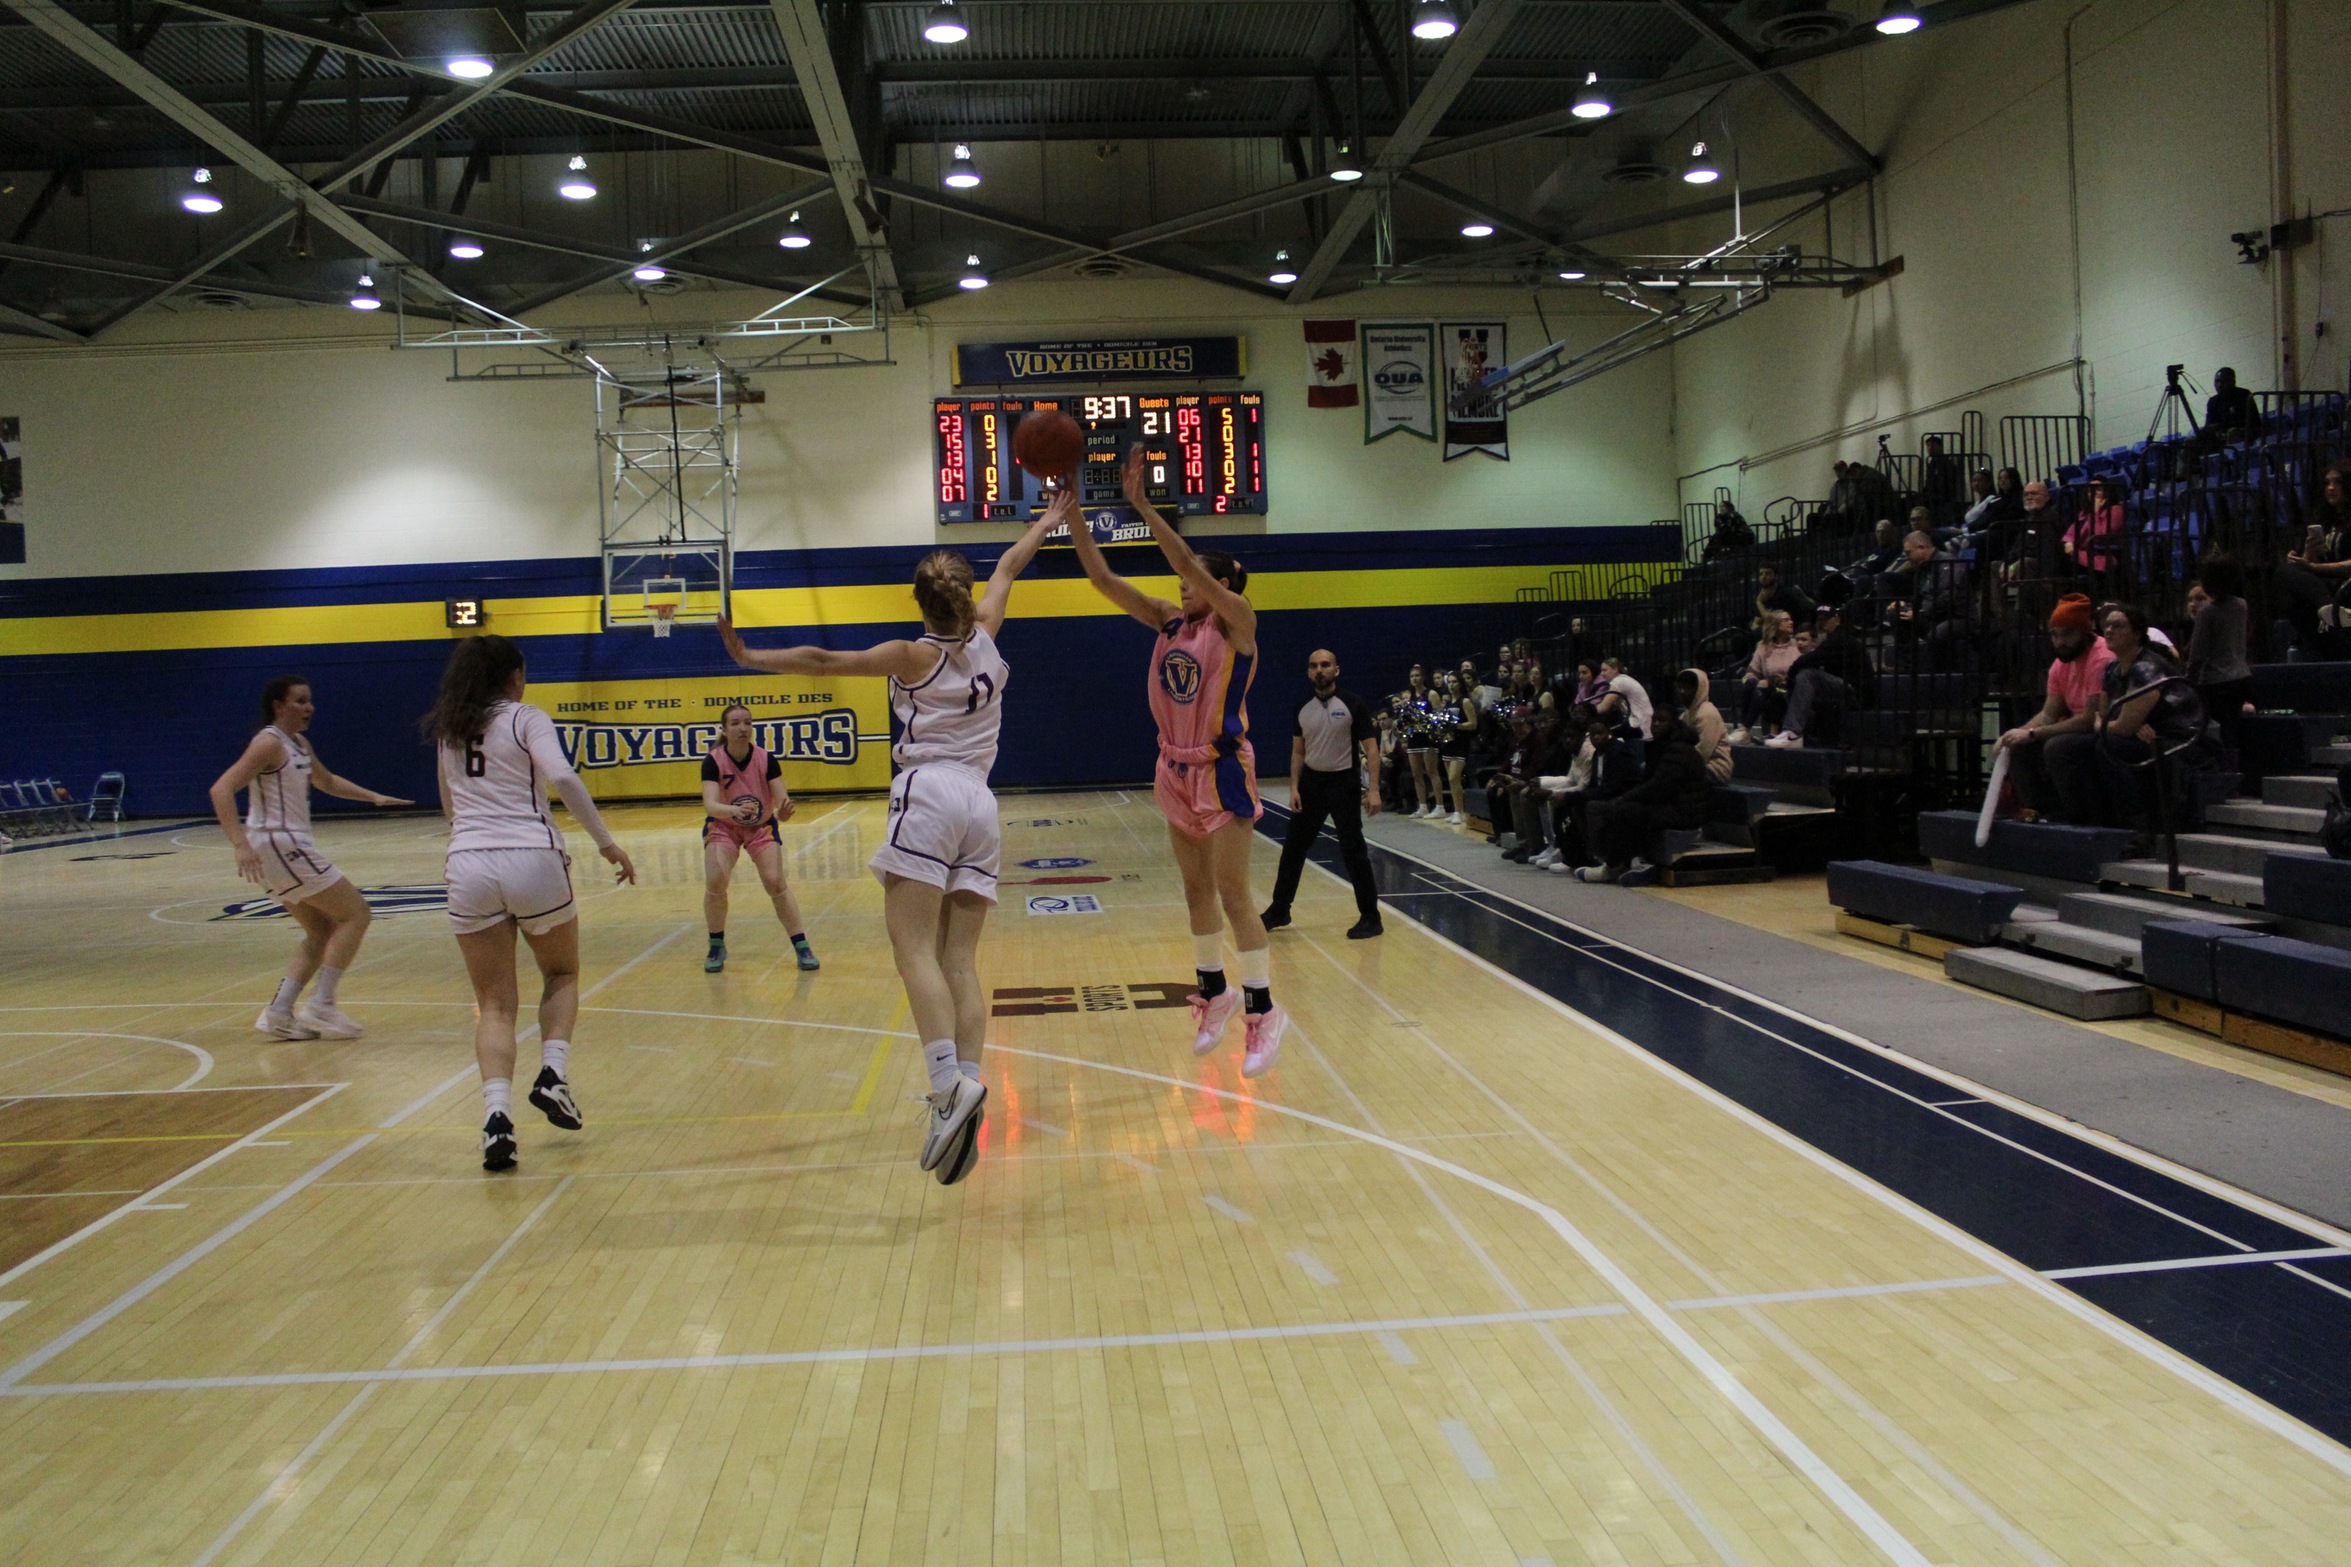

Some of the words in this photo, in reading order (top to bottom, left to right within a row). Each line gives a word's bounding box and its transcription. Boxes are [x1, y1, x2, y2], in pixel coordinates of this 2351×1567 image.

[1006, 346, 1192, 377] VOYAGEURS
[1374, 372, 1424, 384] OUA
[936, 402, 961, 413] player
[970, 401, 995, 411] points
[1002, 401, 1023, 411] fouls
[1033, 401, 1058, 411] Home
[1084, 396, 1131, 419] 9:37
[1139, 397, 1170, 409] Guests
[1175, 396, 1200, 407] player
[1208, 395, 1233, 405] points
[1240, 394, 1260, 404] fouls
[940, 415, 962, 432] 23
[984, 414, 995, 431] 0
[1143, 411, 1171, 434] 21
[1178, 408, 1200, 425] 06
[1222, 407, 1233, 425] 5
[946, 433, 963, 449] 15
[985, 432, 996, 449] 3
[1088, 435, 1115, 446] period
[1179, 426, 1201, 443] 21
[1222, 425, 1234, 442] 0
[947, 450, 963, 467] 13
[991, 450, 997, 465] 1
[1088, 452, 1116, 463] player
[1146, 450, 1167, 460] fouls
[1185, 443, 1202, 459] 13
[1224, 442, 1235, 459] 3
[941, 468, 964, 485] 04
[985, 467, 998, 484] 0
[1153, 465, 1165, 483] 0
[1186, 460, 1202, 477] 10
[1224, 460, 1235, 476] 0
[942, 485, 965, 502] 07
[986, 484, 998, 501] 2
[1149, 488, 1167, 496] won
[1187, 478, 1204, 494] 11
[1224, 477, 1236, 494] 2
[1093, 490, 1115, 500] game
[1215, 495, 1226, 512] 2
[1111, 525, 1155, 541] BRUI
[1161, 617, 1184, 640] 4
[557, 702, 609, 712] HOME
[614, 700, 636, 710] OF
[644, 698, 681, 709] THE
[704, 695, 791, 707] DOMICILE
[797, 692, 833, 704] DES
[552, 710, 858, 771] VOYAGURS
[466, 733, 485, 778] 6
[722, 774, 736, 790] 7
